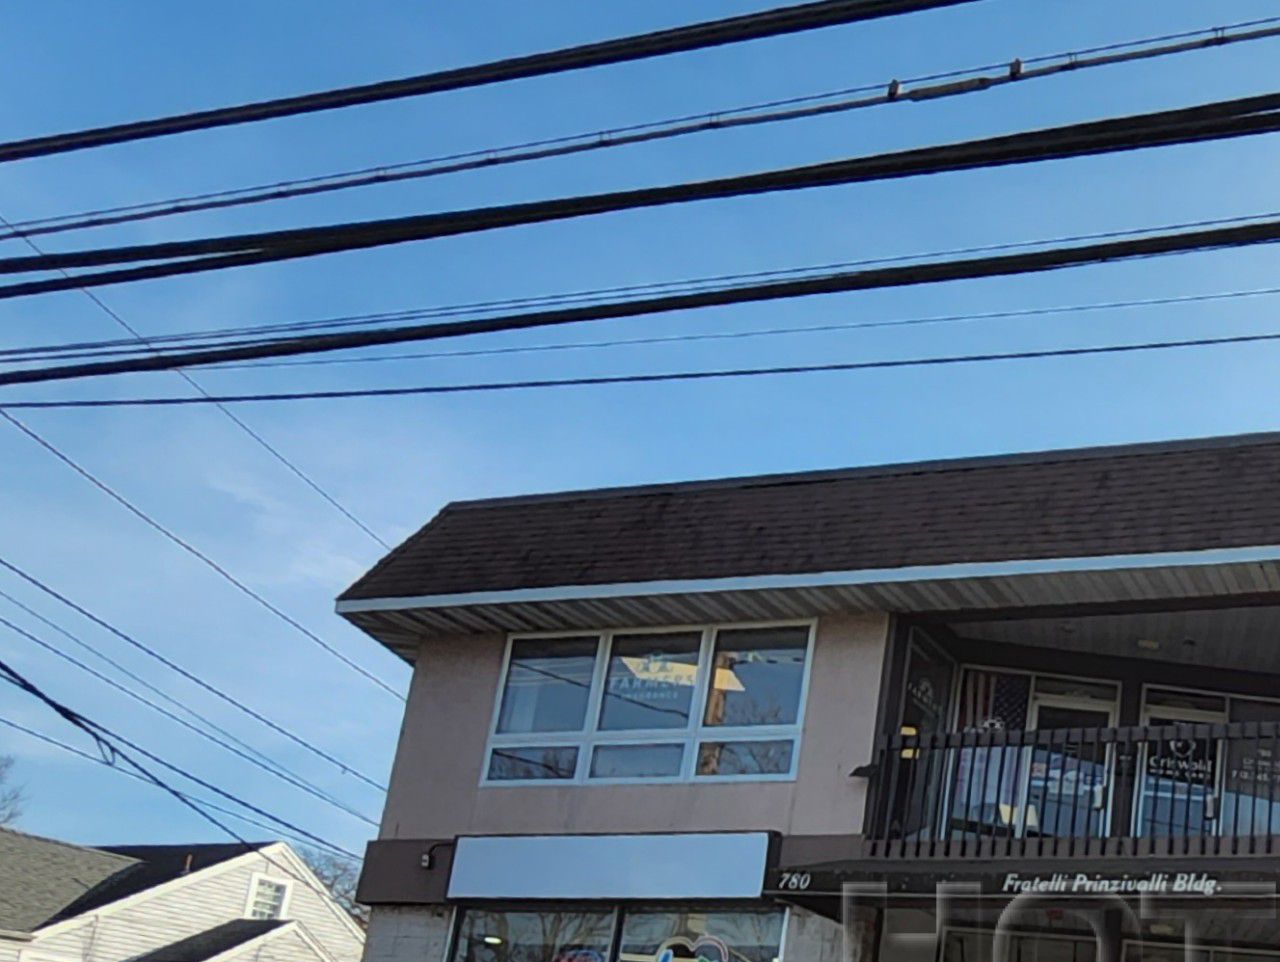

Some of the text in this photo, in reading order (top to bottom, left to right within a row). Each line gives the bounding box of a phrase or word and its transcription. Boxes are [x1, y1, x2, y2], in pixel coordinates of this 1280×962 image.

[778, 873, 812, 889] 780
[1002, 873, 1223, 895] Fratelli Prinzivalli Bldg.
